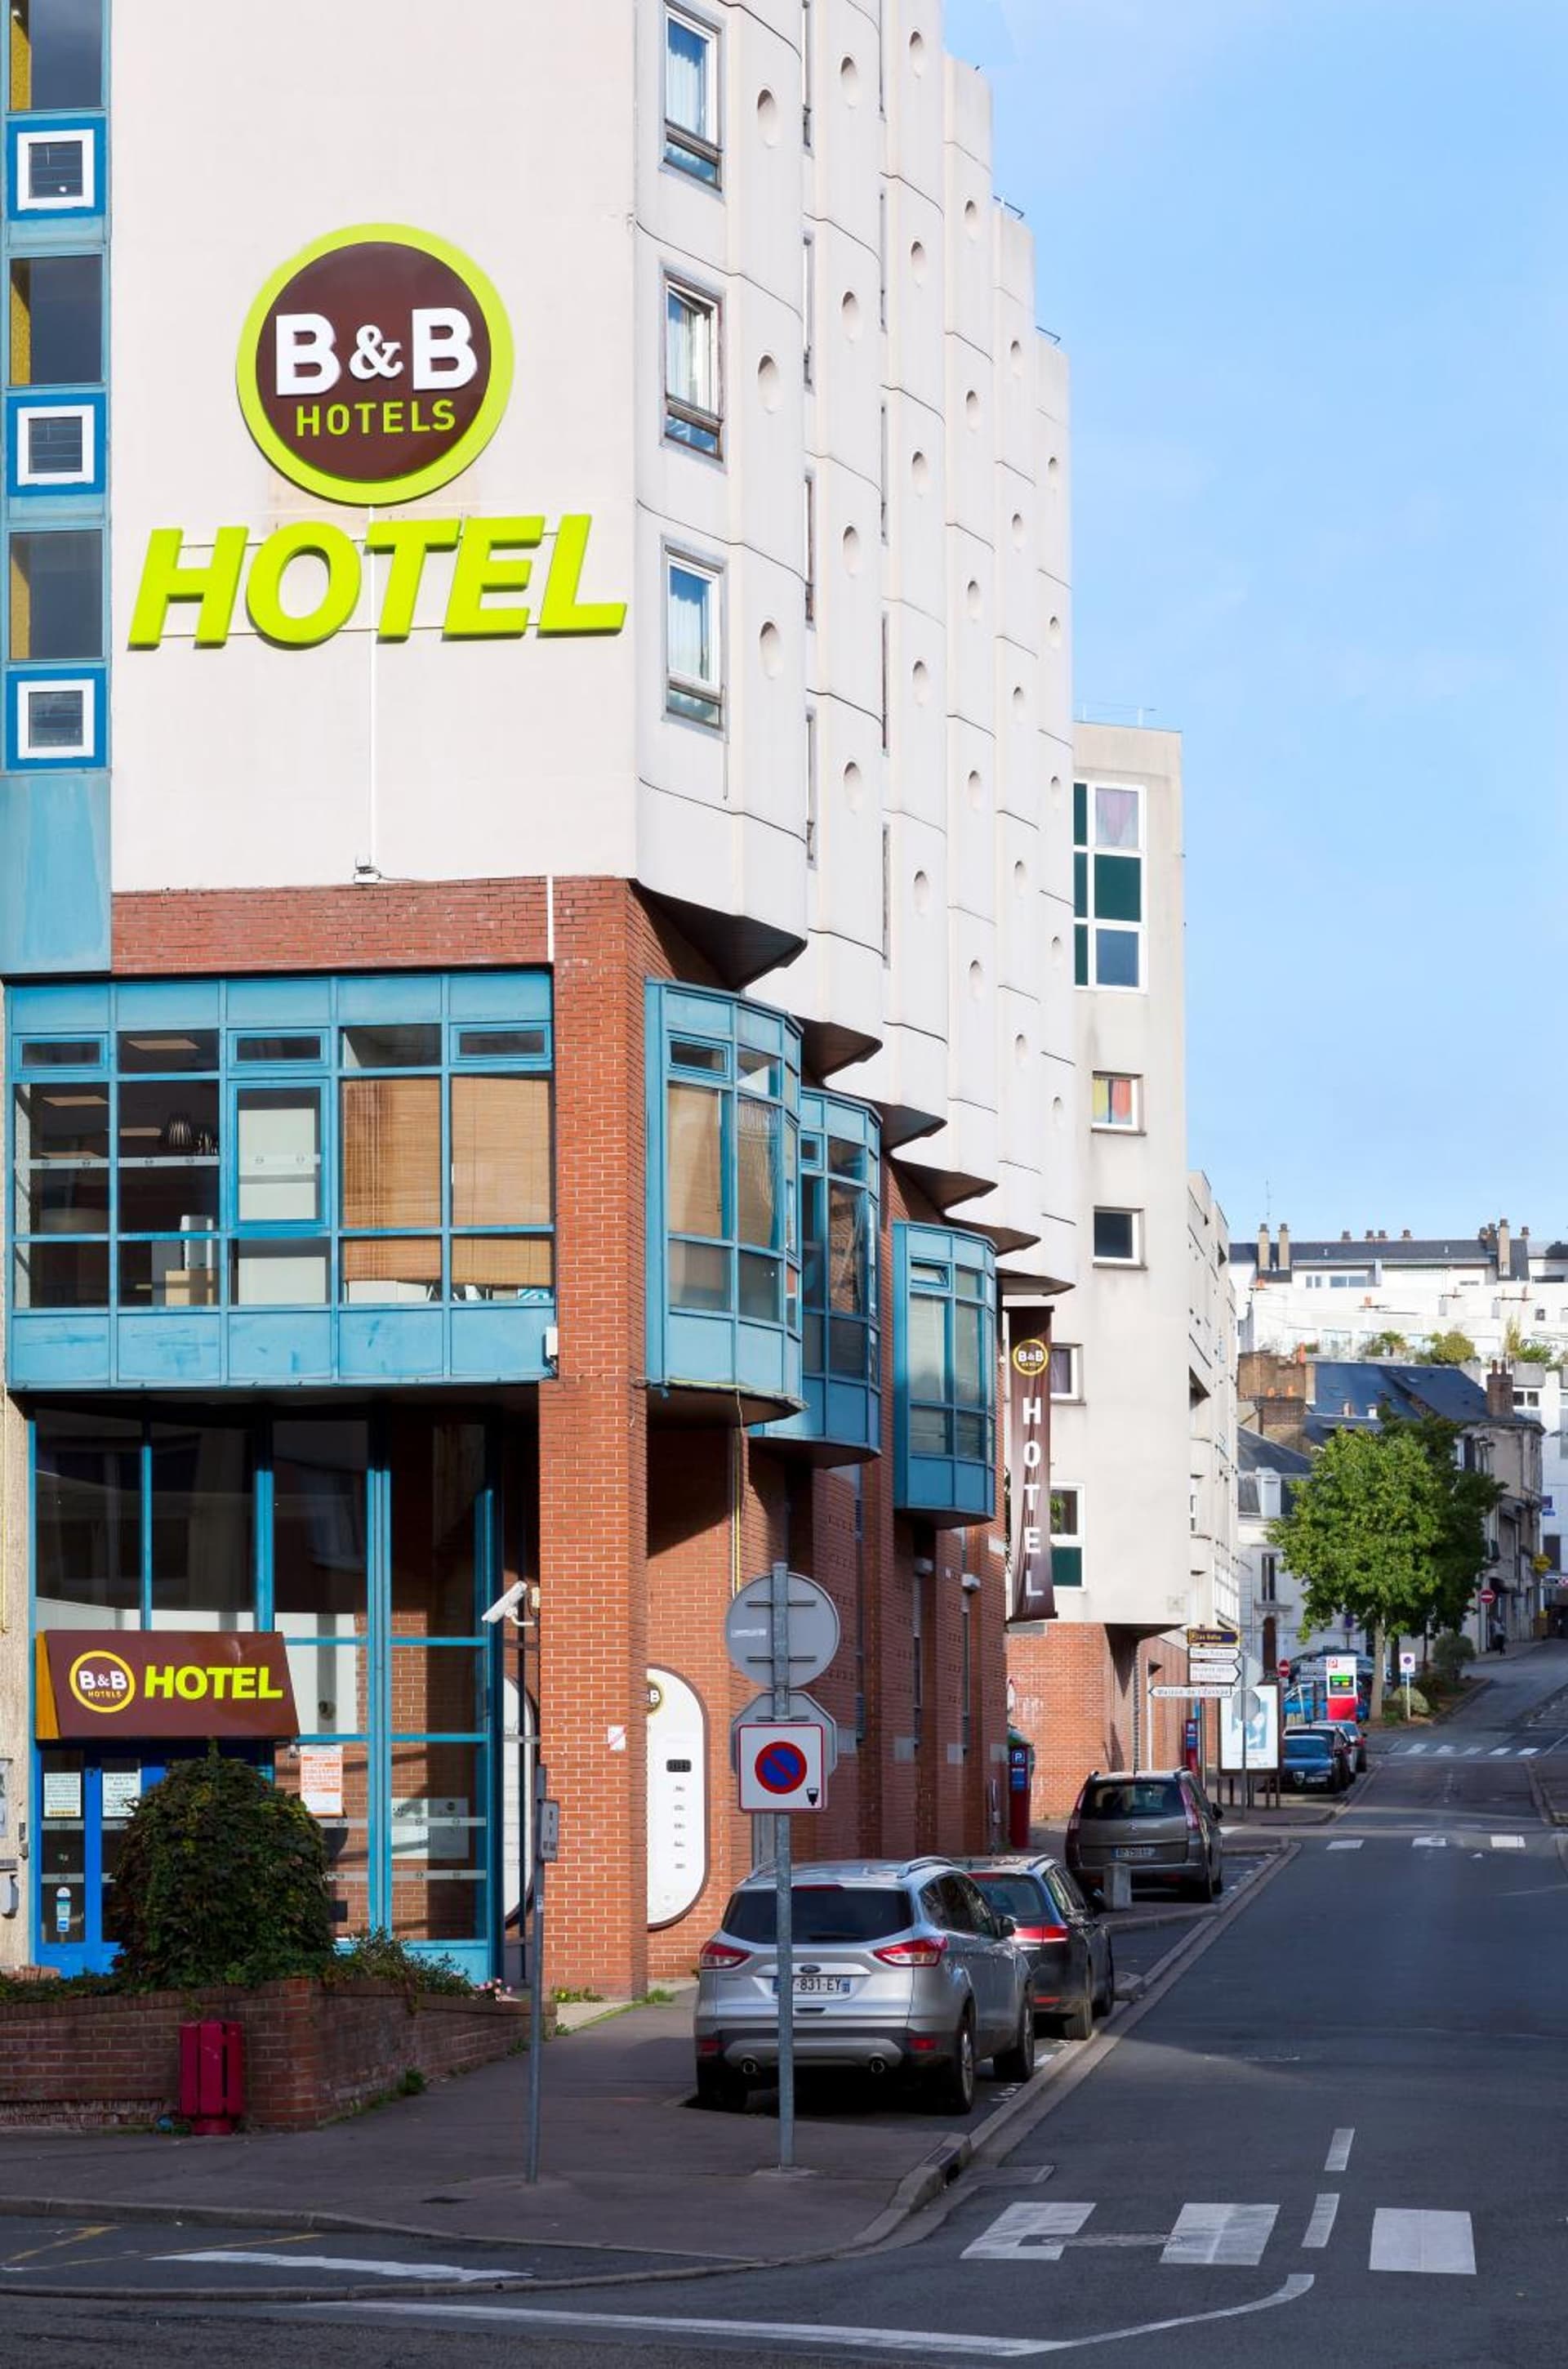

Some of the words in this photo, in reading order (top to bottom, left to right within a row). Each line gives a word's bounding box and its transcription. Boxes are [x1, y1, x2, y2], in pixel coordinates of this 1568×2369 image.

[275, 307, 478, 396] B&B
[296, 399, 457, 436] HOTELS
[128, 514, 627, 651] HOTEL
[1018, 1350, 1044, 1363] B&B
[1022, 1397, 1043, 1596] HOTEL
[78, 1670, 127, 1690] B&B
[87, 1690, 122, 1699] HOTELS
[144, 1665, 283, 1700] HOTEL
[791, 1978, 841, 1991] -831-EY
